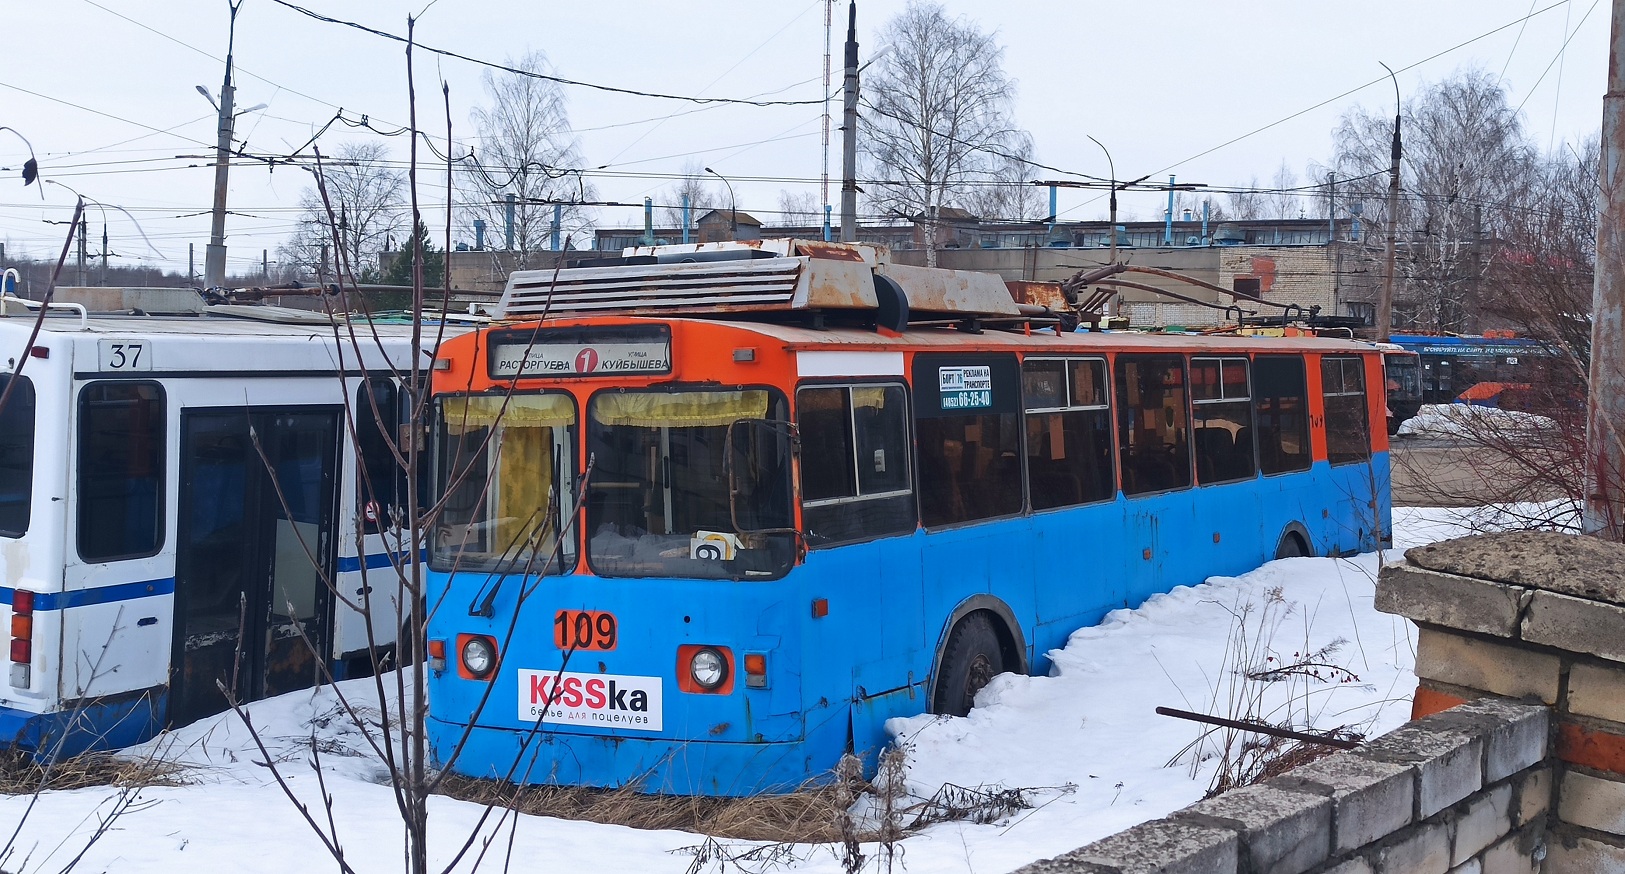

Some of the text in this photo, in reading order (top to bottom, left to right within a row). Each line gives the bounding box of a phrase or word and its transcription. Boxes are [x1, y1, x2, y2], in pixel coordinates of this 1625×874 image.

[110, 344, 143, 369] 37
[499, 360, 570, 371] РАСТОРГУЕВА
[580, 350, 591, 373] 1
[601, 358, 668, 370] КУЙБЫШЕВА
[958, 391, 990, 407] 66-25-40
[554, 610, 617, 650] 109
[530, 706, 649, 724] белье для поцелуев
